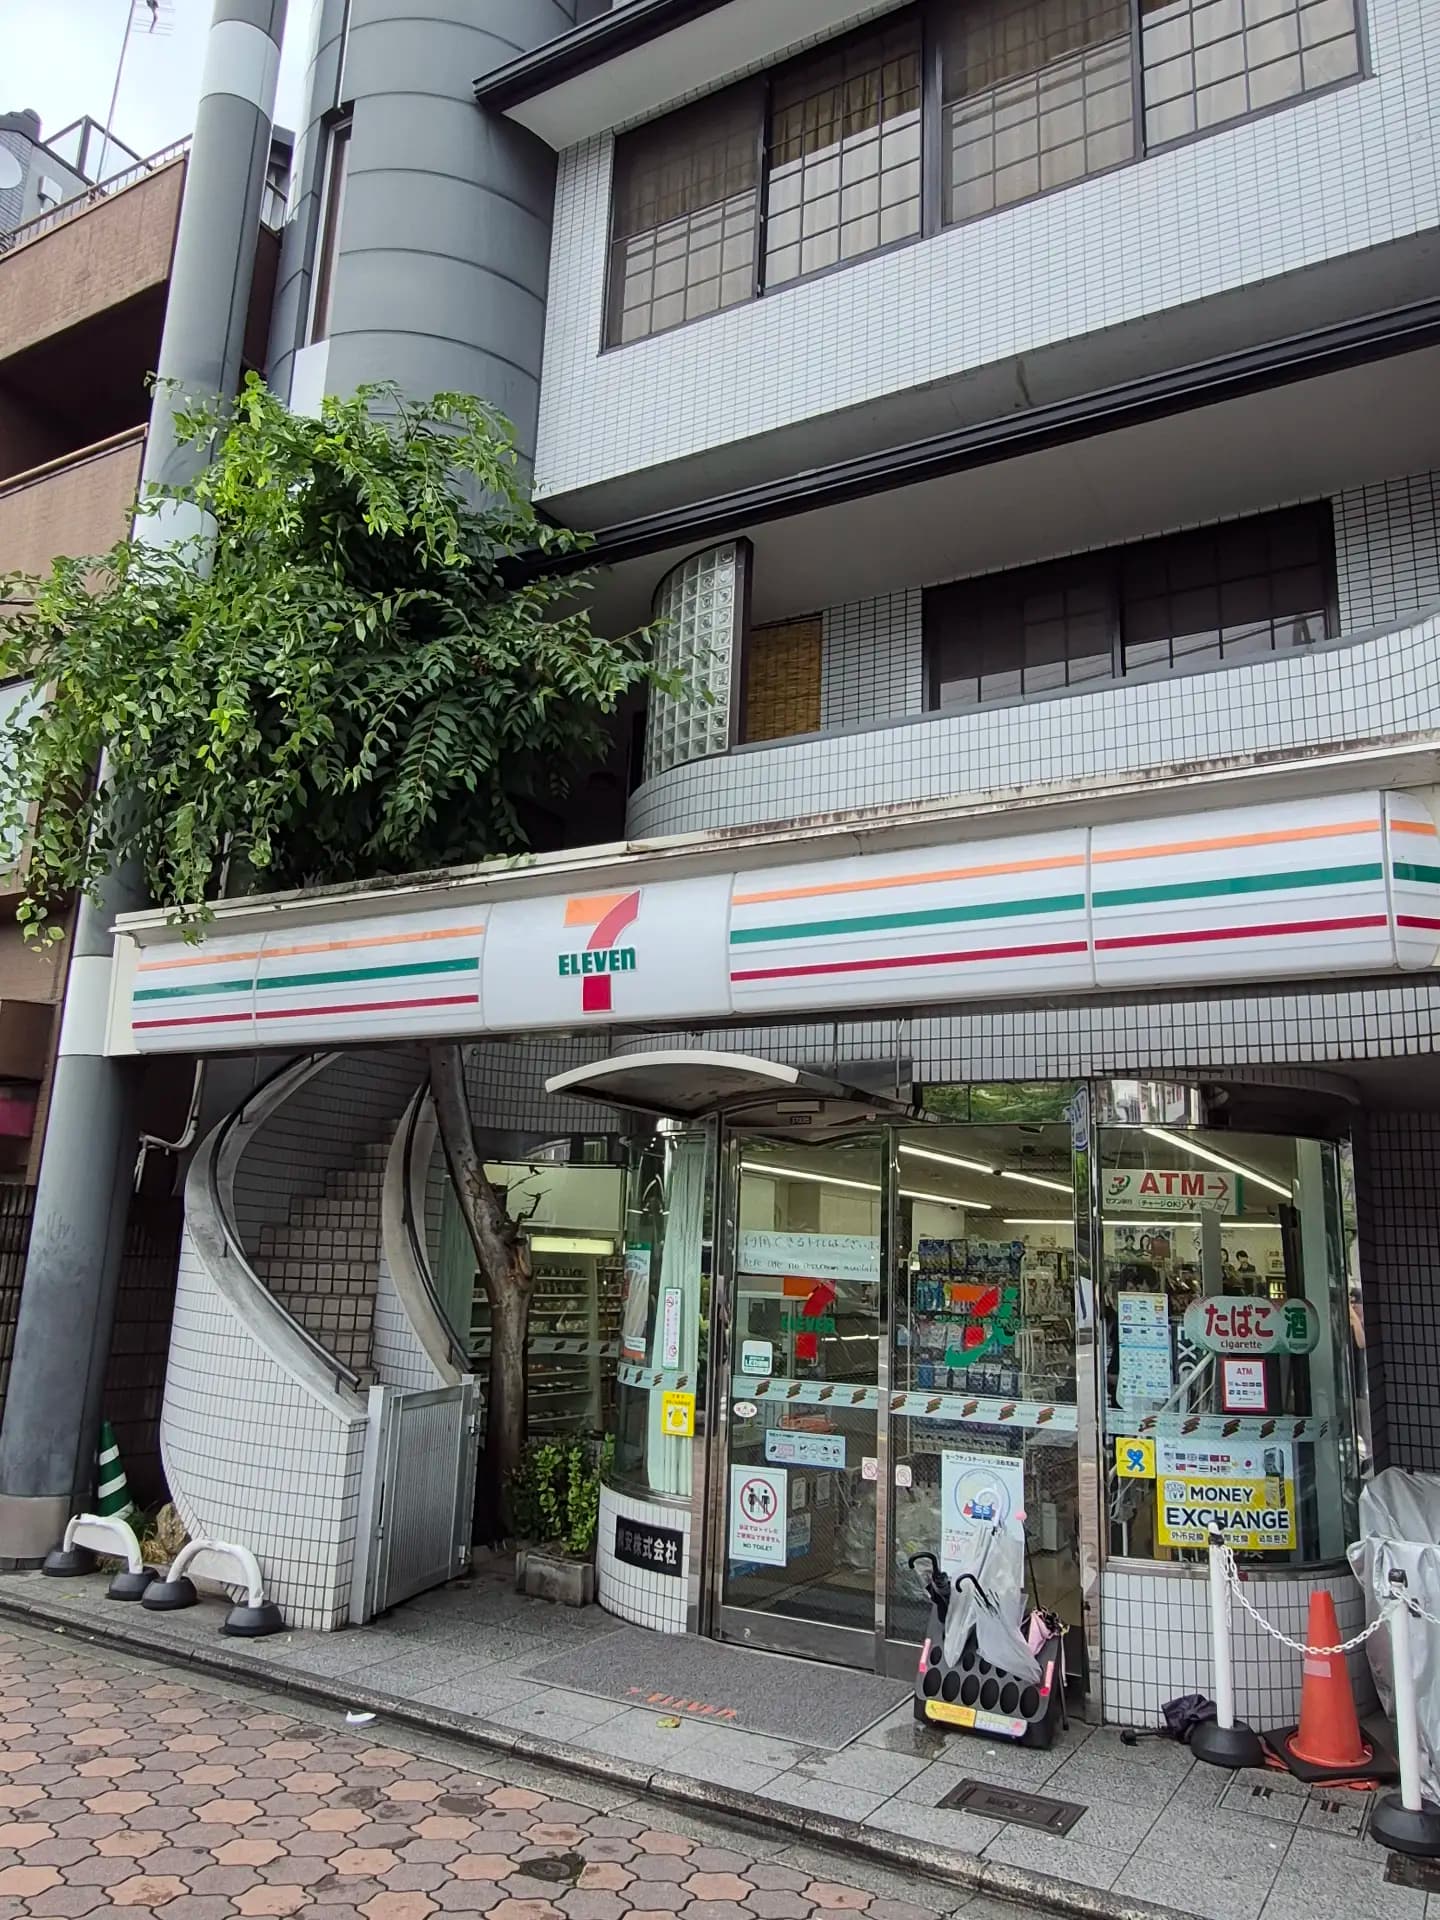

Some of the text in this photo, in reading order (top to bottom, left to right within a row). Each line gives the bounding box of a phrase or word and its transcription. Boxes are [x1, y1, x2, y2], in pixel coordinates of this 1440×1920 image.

[1140, 1172, 1205, 1196] ATM
[1205, 1304, 1308, 1339] たばこ 酒
[1220, 1340, 1263, 1350] cigarette
[1190, 1486, 1254, 1503] MONEY
[1166, 1507, 1290, 1530] EXCHANGE
